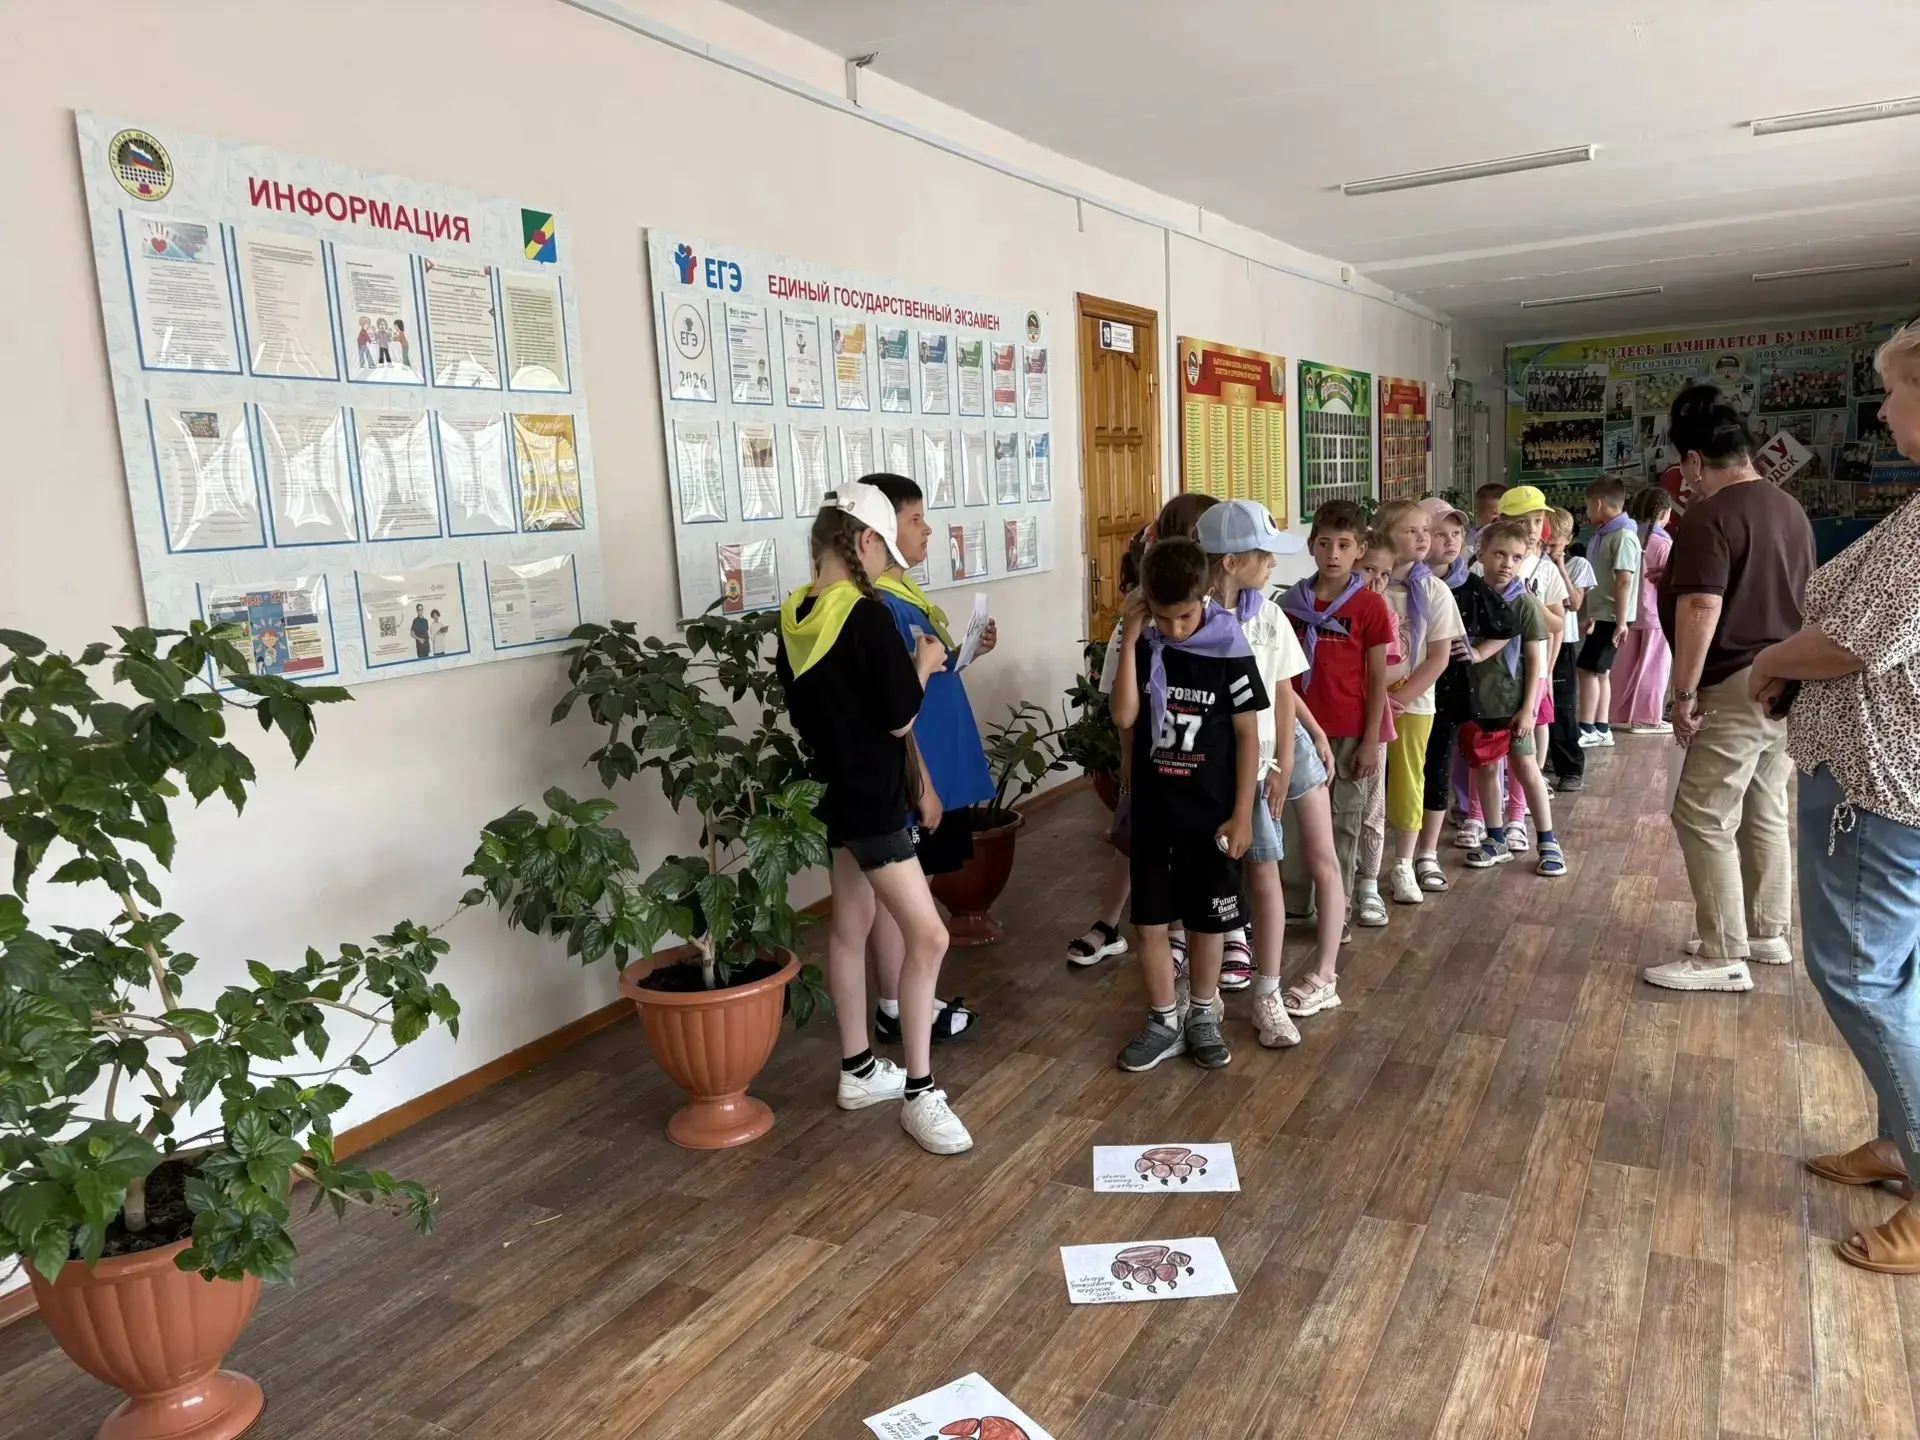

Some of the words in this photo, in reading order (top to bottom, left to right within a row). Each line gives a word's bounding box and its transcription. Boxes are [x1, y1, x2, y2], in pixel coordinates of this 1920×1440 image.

[247, 177, 471, 244] ИНФОРМАЦИЯ
[704, 256, 743, 294] ЕГЭ
[767, 272, 831, 304] ЕДИНЫЙ
[833, 286, 952, 324] ГОСУДАРСТВЕННЫЙ
[954, 310, 1001, 331] ЭКЗАМЕН
[680, 331, 698, 348] ЕГЭ
[1607, 345, 1655, 360] ЗДЕСЬ
[1662, 334, 1767, 355] НАЧИНАЕТСЯ
[679, 370, 707, 390] 2026
[1142, 682, 1216, 705] AFORNIA
[1176, 753, 1206, 762] LEAGUE
[1212, 895, 1237, 909] Future
